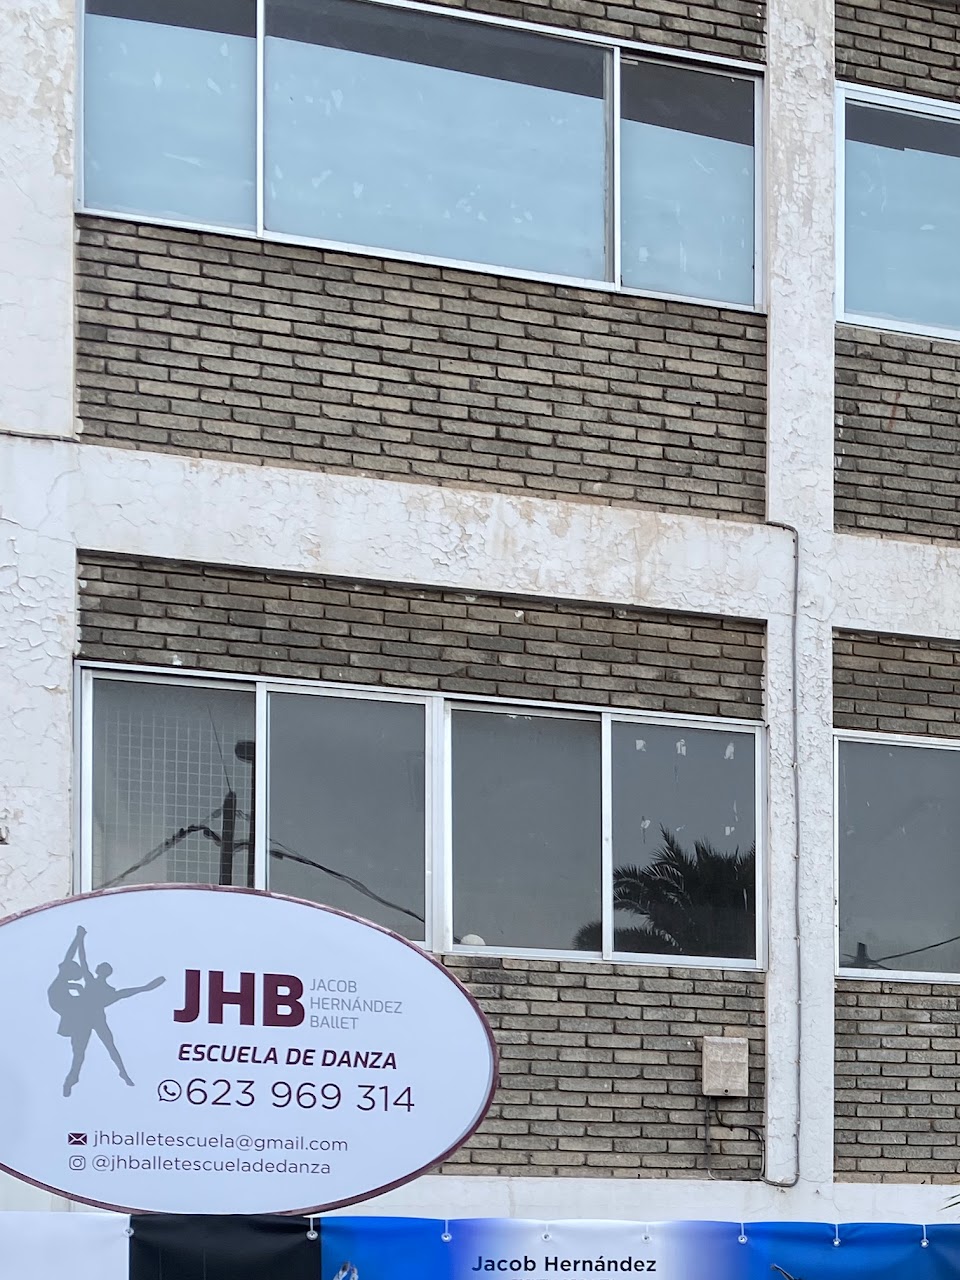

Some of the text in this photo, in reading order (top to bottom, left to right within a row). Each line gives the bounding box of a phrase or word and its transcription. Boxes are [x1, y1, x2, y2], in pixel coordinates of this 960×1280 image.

[309, 978, 358, 994] JACOB
[173, 969, 305, 1028] JHB
[309, 996, 403, 1015] HERNÁNDEZ
[178, 1043, 397, 1071] ESCUELA DE DANZA
[186, 1078, 415, 1113] 623 969 314
[93, 1130, 349, 1153] jhballetescuela@gmail.com
[91, 1154, 331, 1175] @jhballetescueladedanza
[471, 1256, 657, 1272] Jacob Hernández
